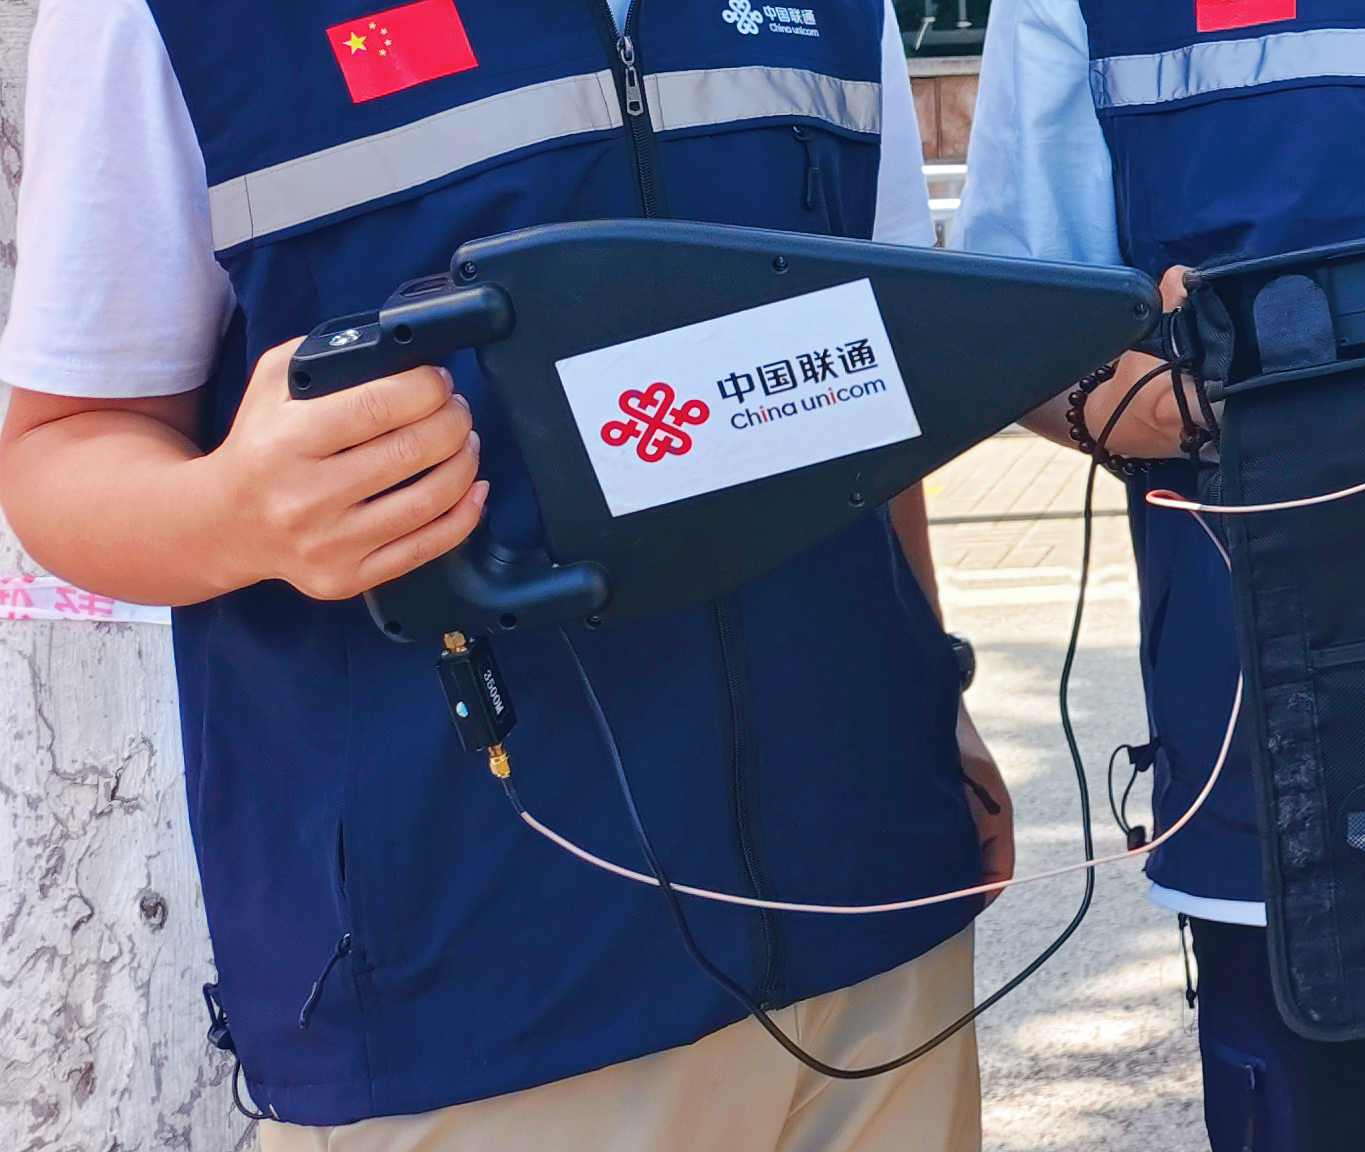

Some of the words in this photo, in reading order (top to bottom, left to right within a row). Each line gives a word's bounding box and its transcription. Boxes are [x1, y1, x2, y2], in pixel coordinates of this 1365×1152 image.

[762, 5, 817, 25] 中国联通
[717, 338, 879, 404] 中国联通
[730, 402, 799, 431] China
[801, 376, 887, 412] unicom
